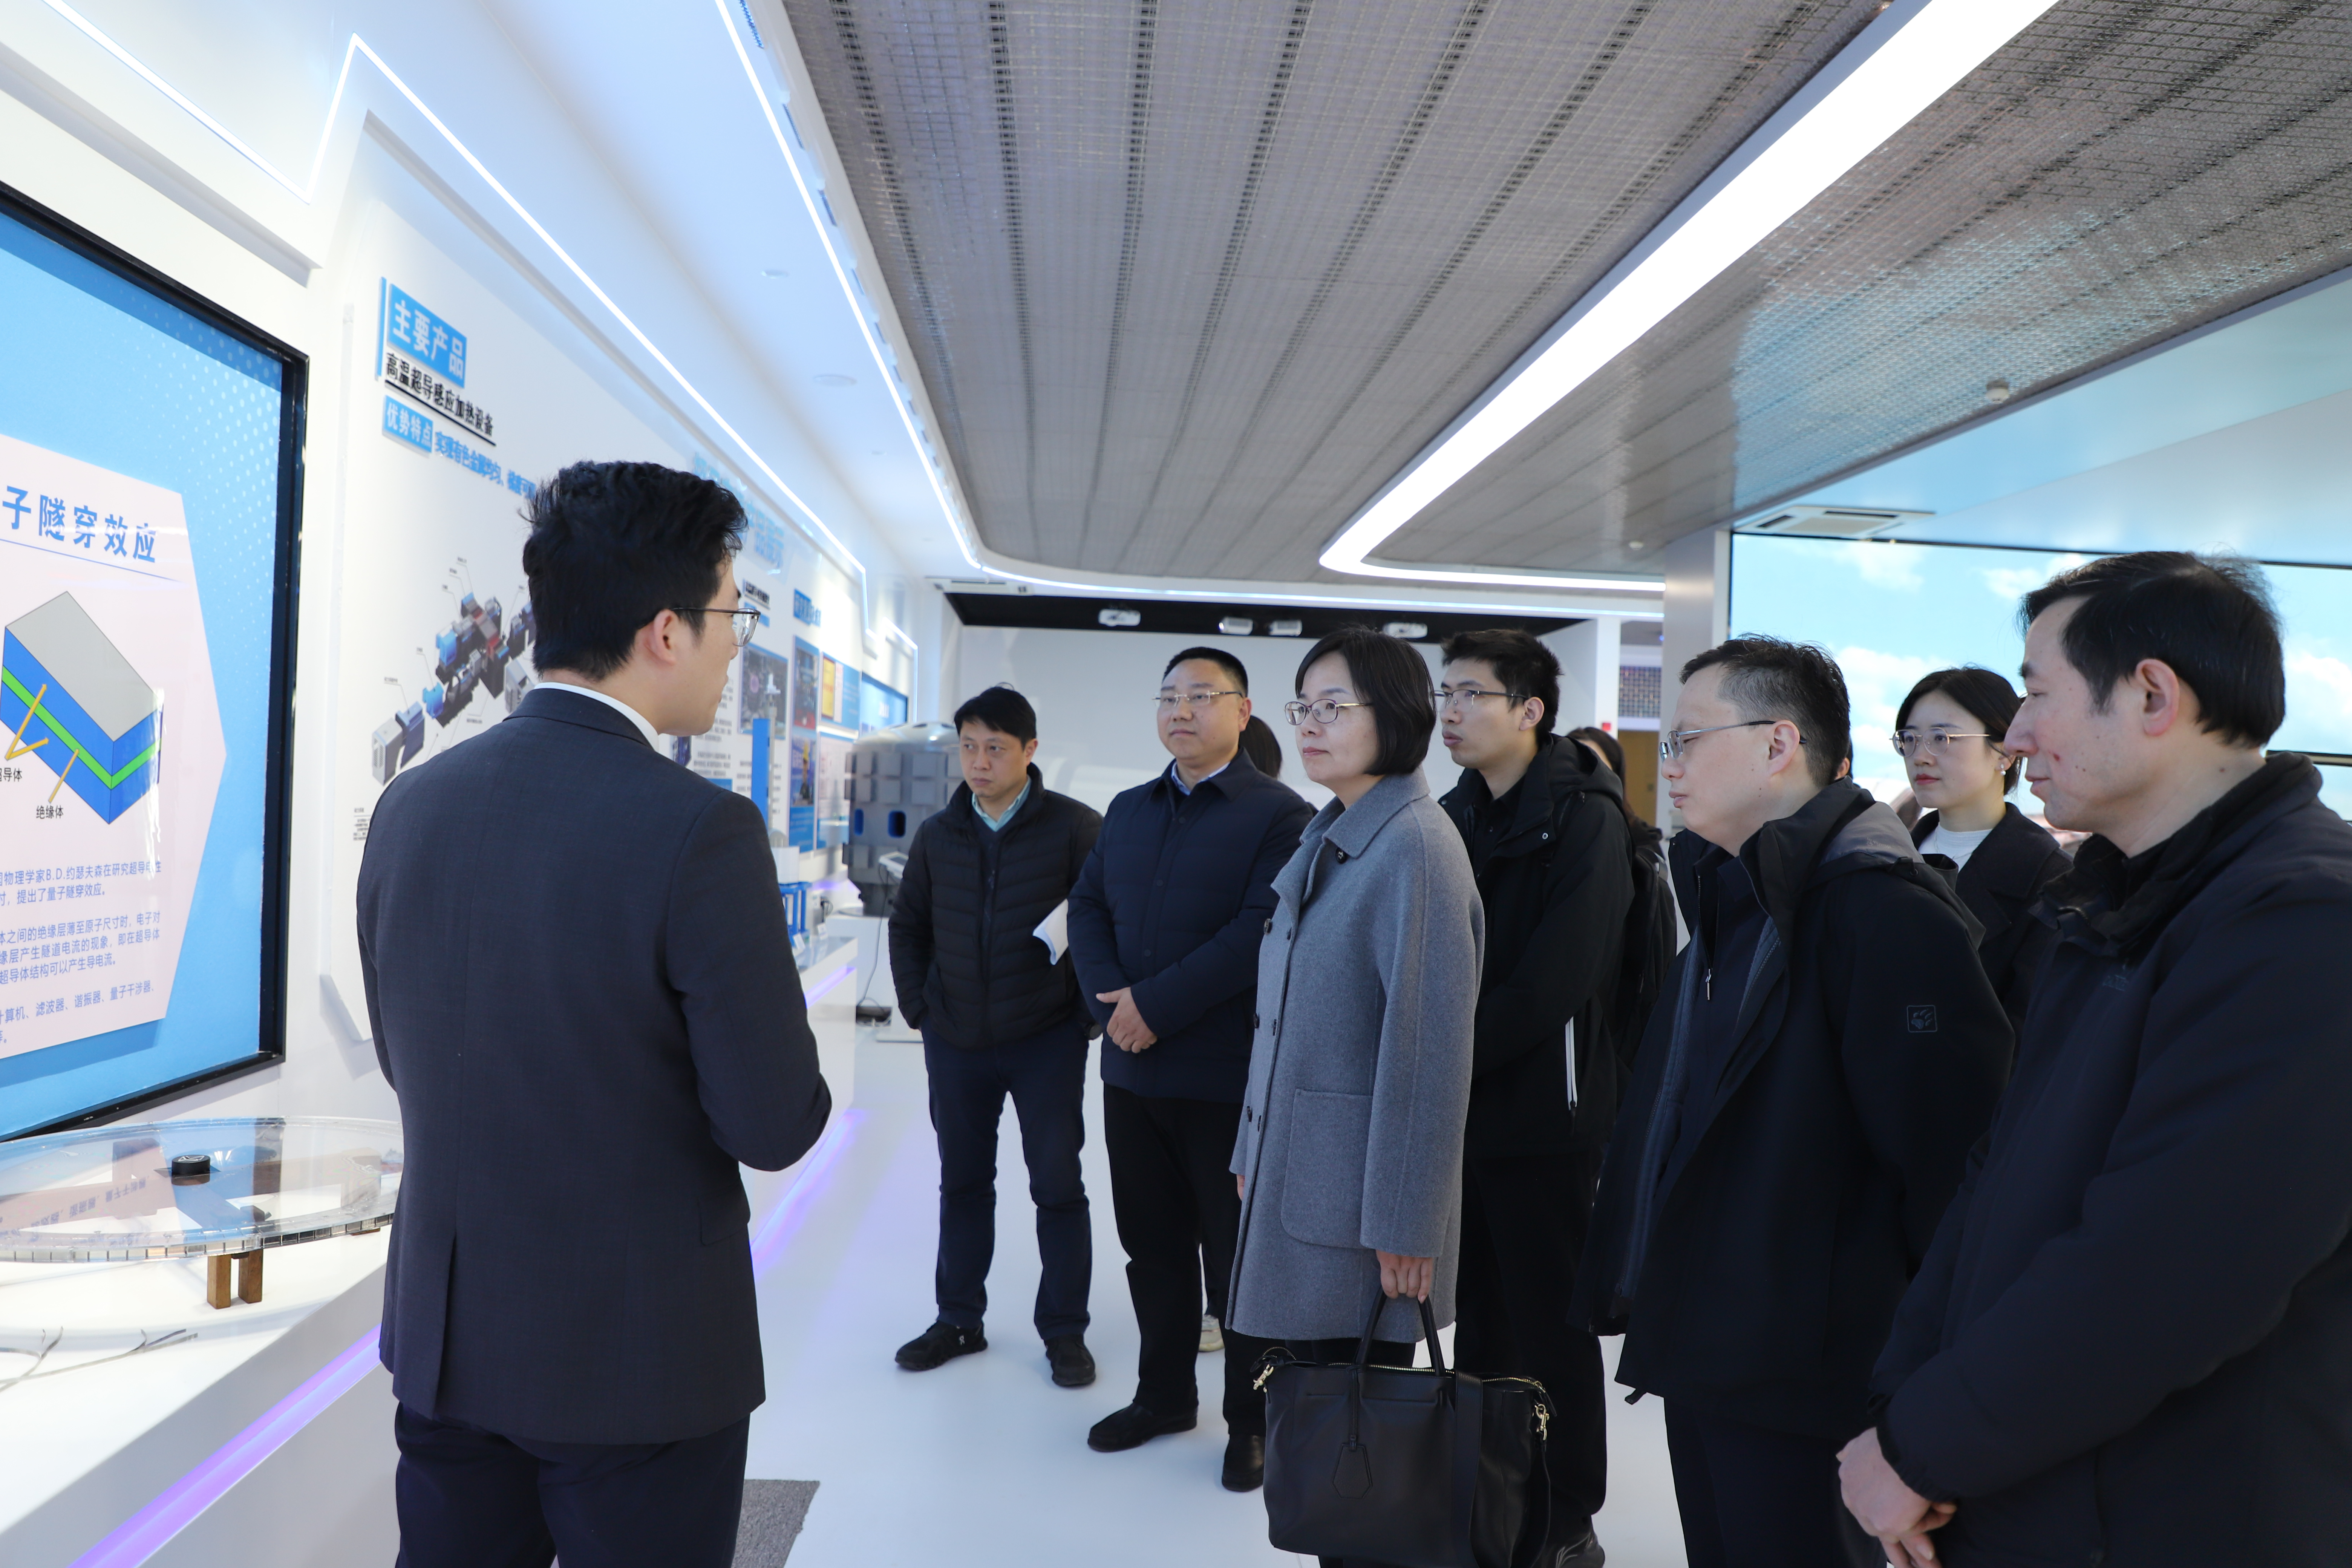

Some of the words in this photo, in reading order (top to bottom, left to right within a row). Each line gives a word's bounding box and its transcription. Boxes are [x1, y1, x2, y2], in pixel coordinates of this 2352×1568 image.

[392, 299, 464, 380] 主要产品
[386, 352, 494, 436] 高温超导感应加热设备
[387, 401, 432, 447] 优势特点
[3, 485, 156, 563] 子隧穿效应
[0, 767, 23, 782] 导体
[36, 805, 64, 819] 绝缘体
